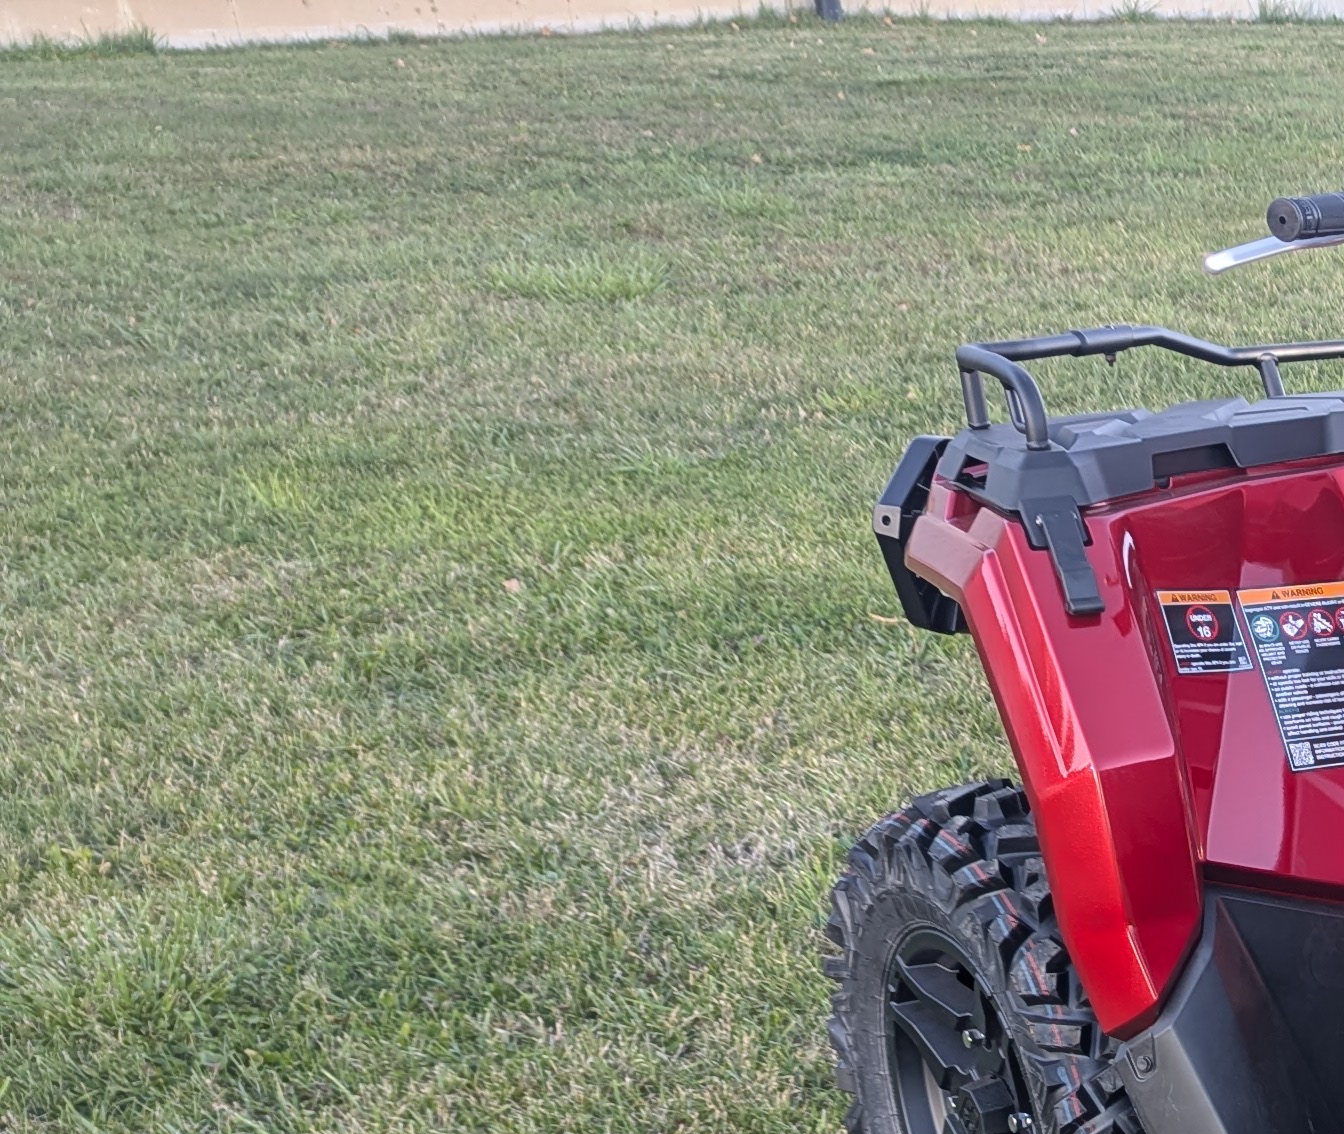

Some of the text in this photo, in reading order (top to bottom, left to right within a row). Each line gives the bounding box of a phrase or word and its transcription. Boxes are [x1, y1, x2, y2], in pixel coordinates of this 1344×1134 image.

[1282, 586, 1324, 598] WARNING
[1179, 593, 1218, 602] WARNING
[1189, 614, 1212, 622] UNDER
[1197, 626, 1212, 638] 16
